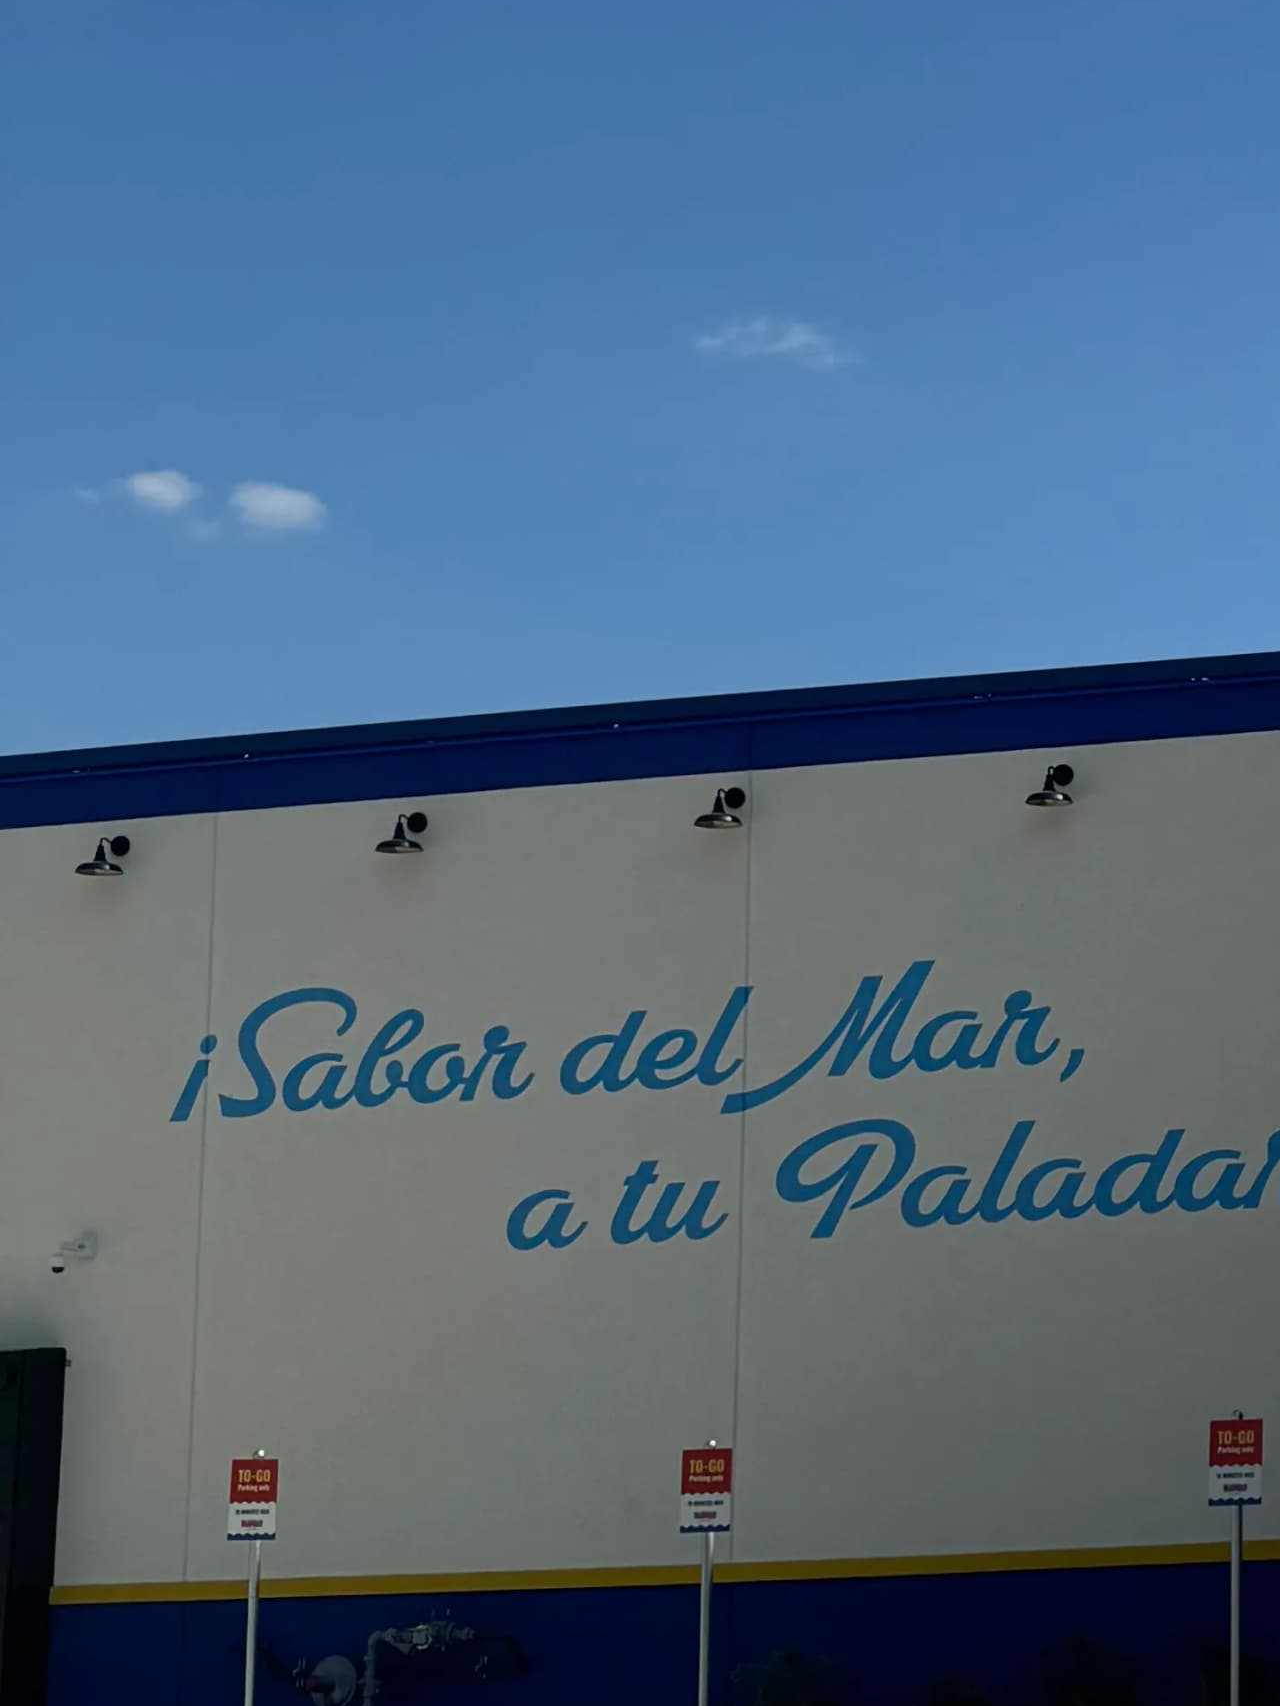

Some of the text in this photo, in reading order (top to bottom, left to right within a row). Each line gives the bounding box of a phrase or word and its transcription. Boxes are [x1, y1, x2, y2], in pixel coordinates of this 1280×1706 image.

[171, 960, 1085, 1122] ¡Sabor del Mar,
[506, 1188, 586, 1251] a
[610, 1160, 728, 1246] tu
[1217, 1429, 1255, 1445] TO-GO
[689, 1458, 725, 1474] TO-GO
[238, 1469, 271, 1483] TO-GO
